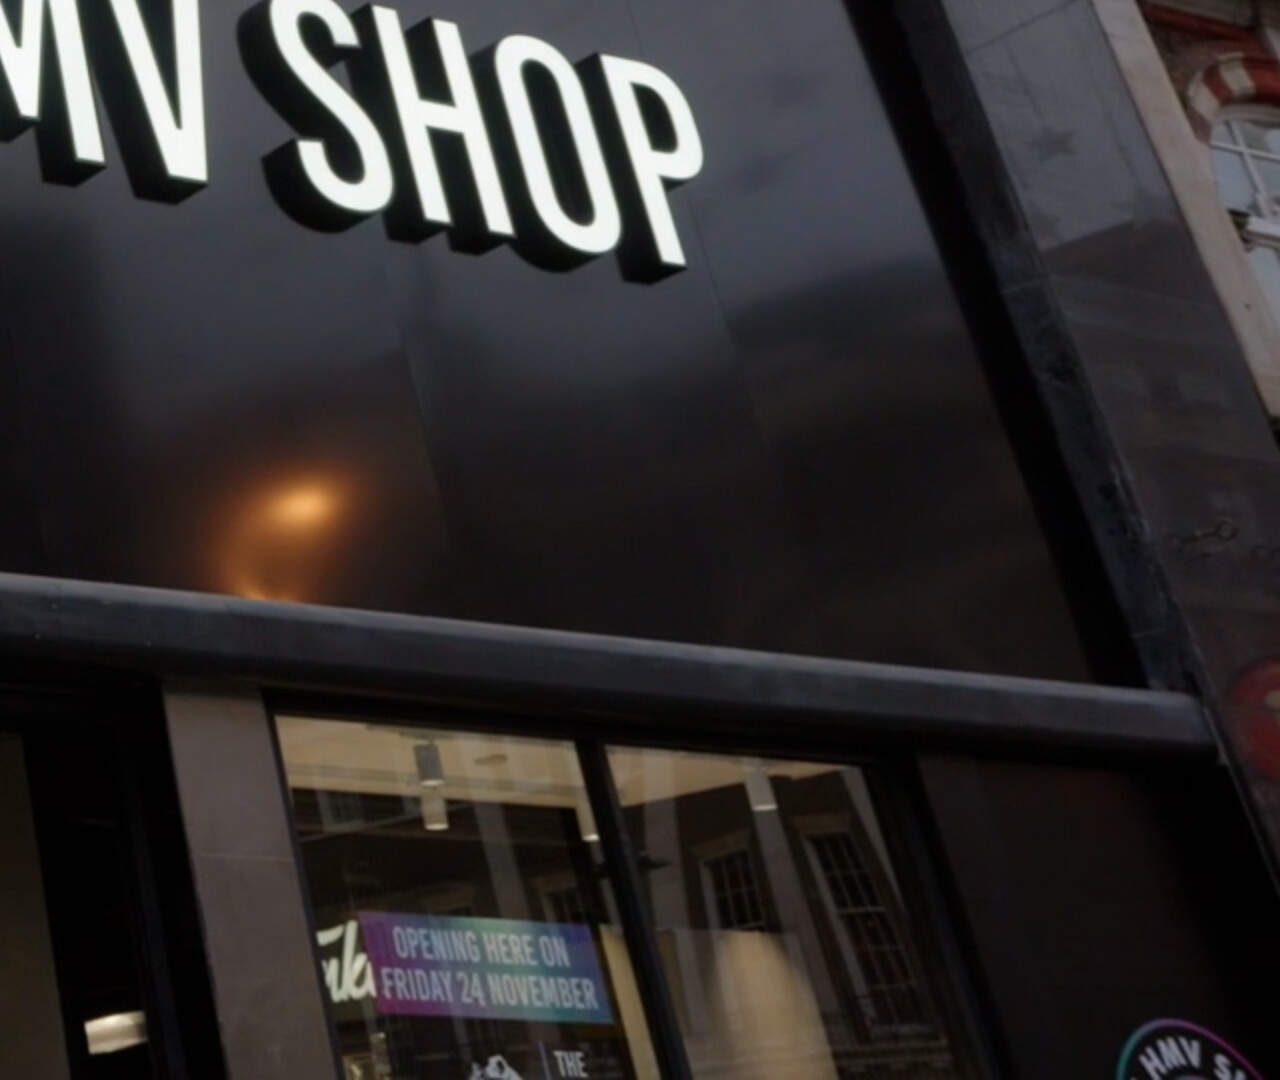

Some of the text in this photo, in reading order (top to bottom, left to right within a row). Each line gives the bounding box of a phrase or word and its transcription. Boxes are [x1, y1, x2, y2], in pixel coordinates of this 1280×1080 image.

[392, 926, 571, 968] OPENING HERE ON
[380, 966, 599, 1010] FRIDAY 24 NOVEMBER
[553, 1050, 588, 1078] THE
[1140, 1037, 1200, 1080] HMV
